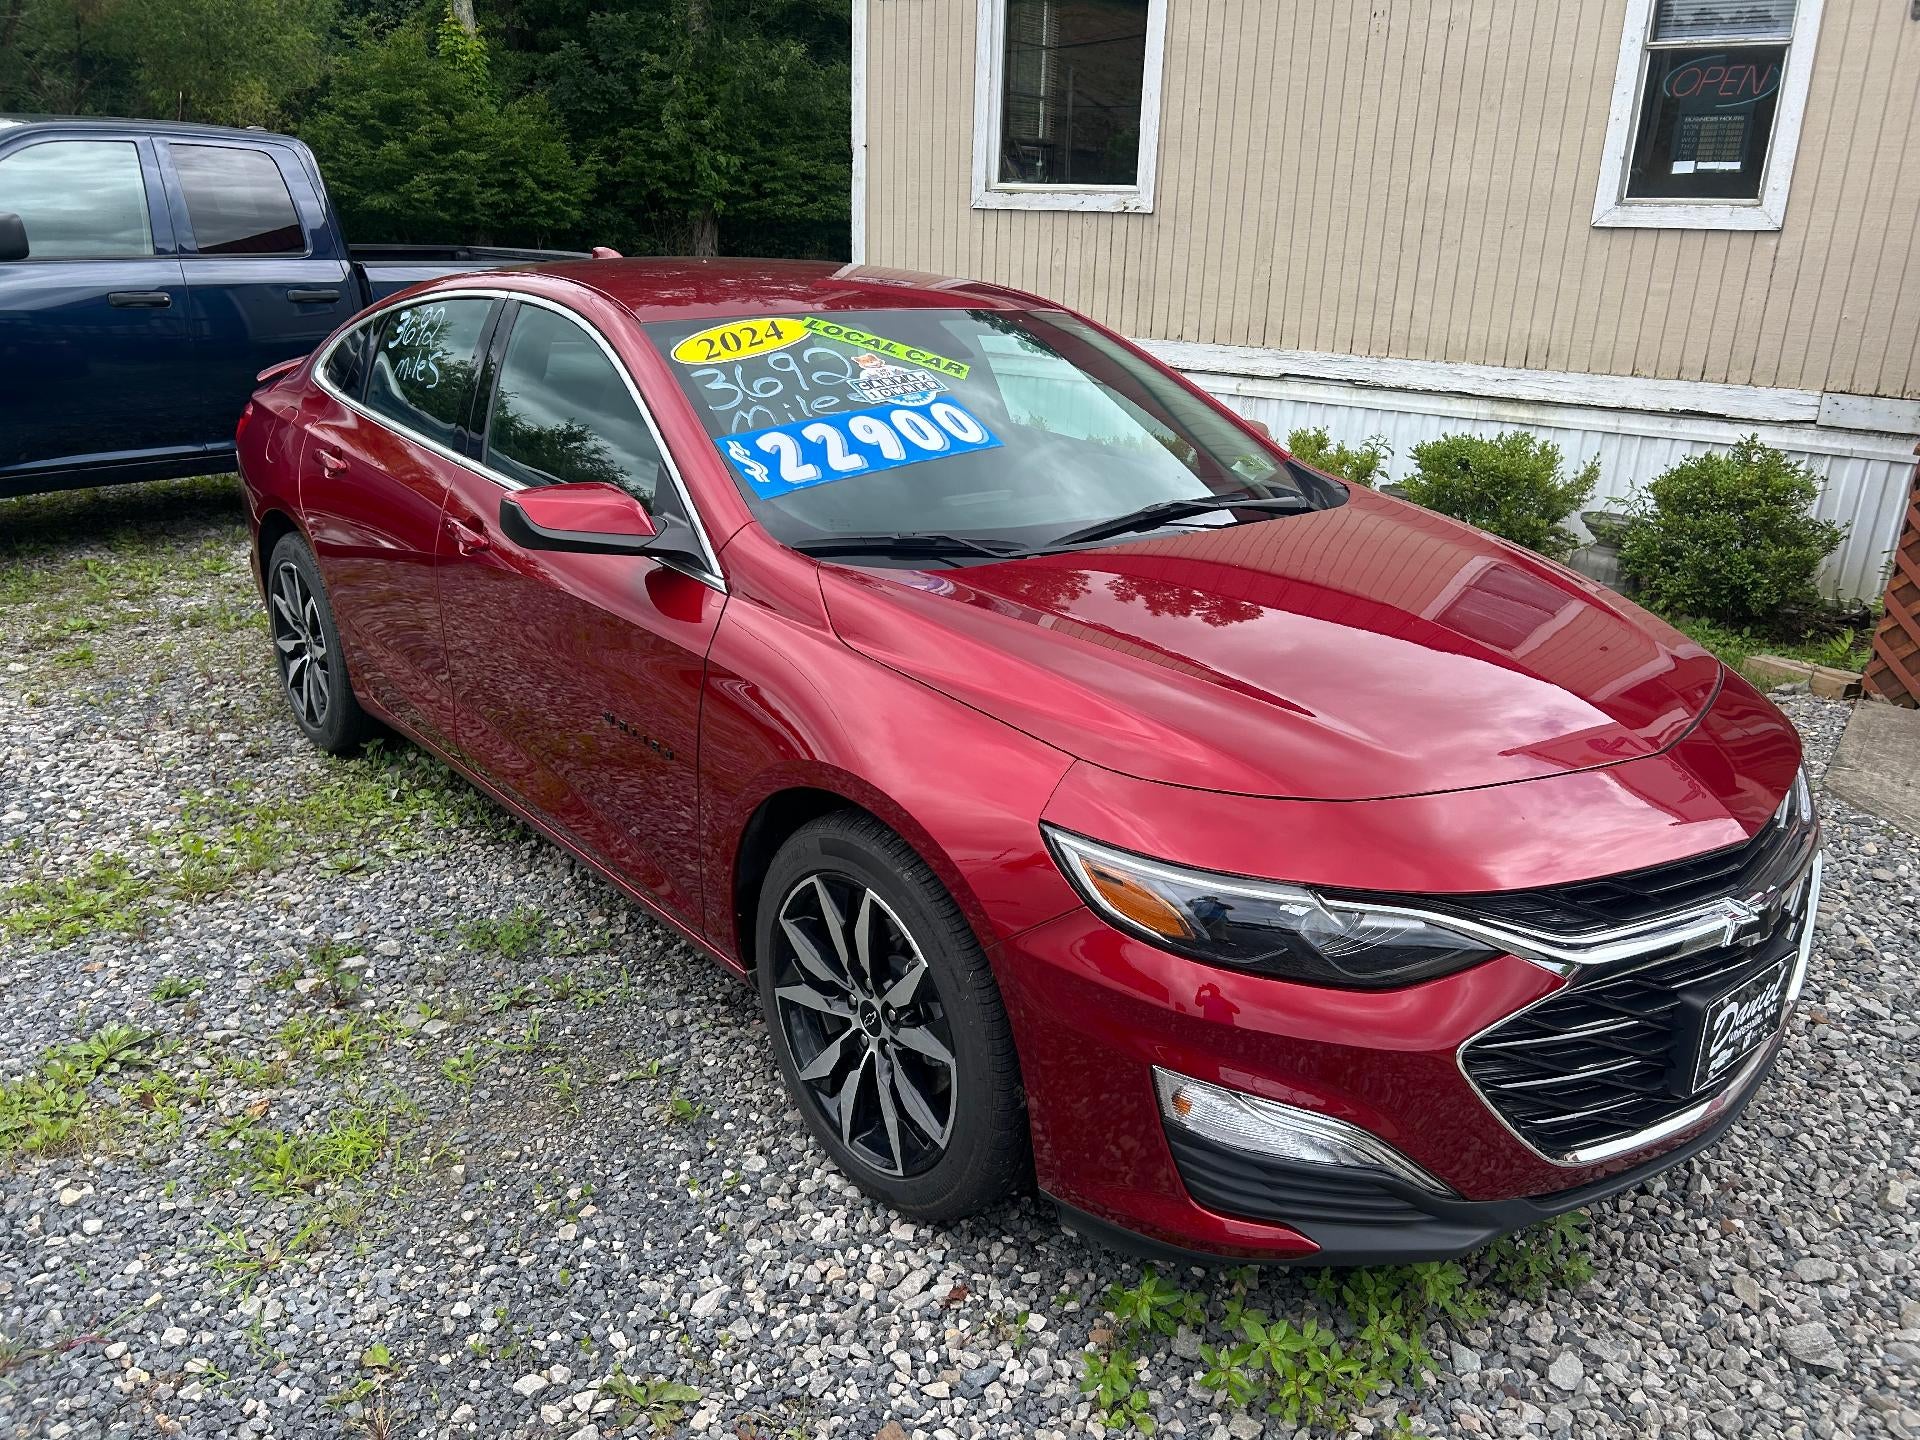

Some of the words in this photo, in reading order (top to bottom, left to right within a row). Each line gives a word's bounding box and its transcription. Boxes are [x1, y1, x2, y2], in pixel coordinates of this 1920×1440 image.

[1672, 64, 1773, 97] OPEN
[388, 306, 446, 349] 3692
[696, 320, 785, 361] 2024
[804, 320, 897, 354] LOCAL
[905, 350, 965, 375] CAR
[690, 347, 853, 411] 3692
[727, 401, 990, 484] $22900
[1709, 966, 1787, 1058] Daniel
